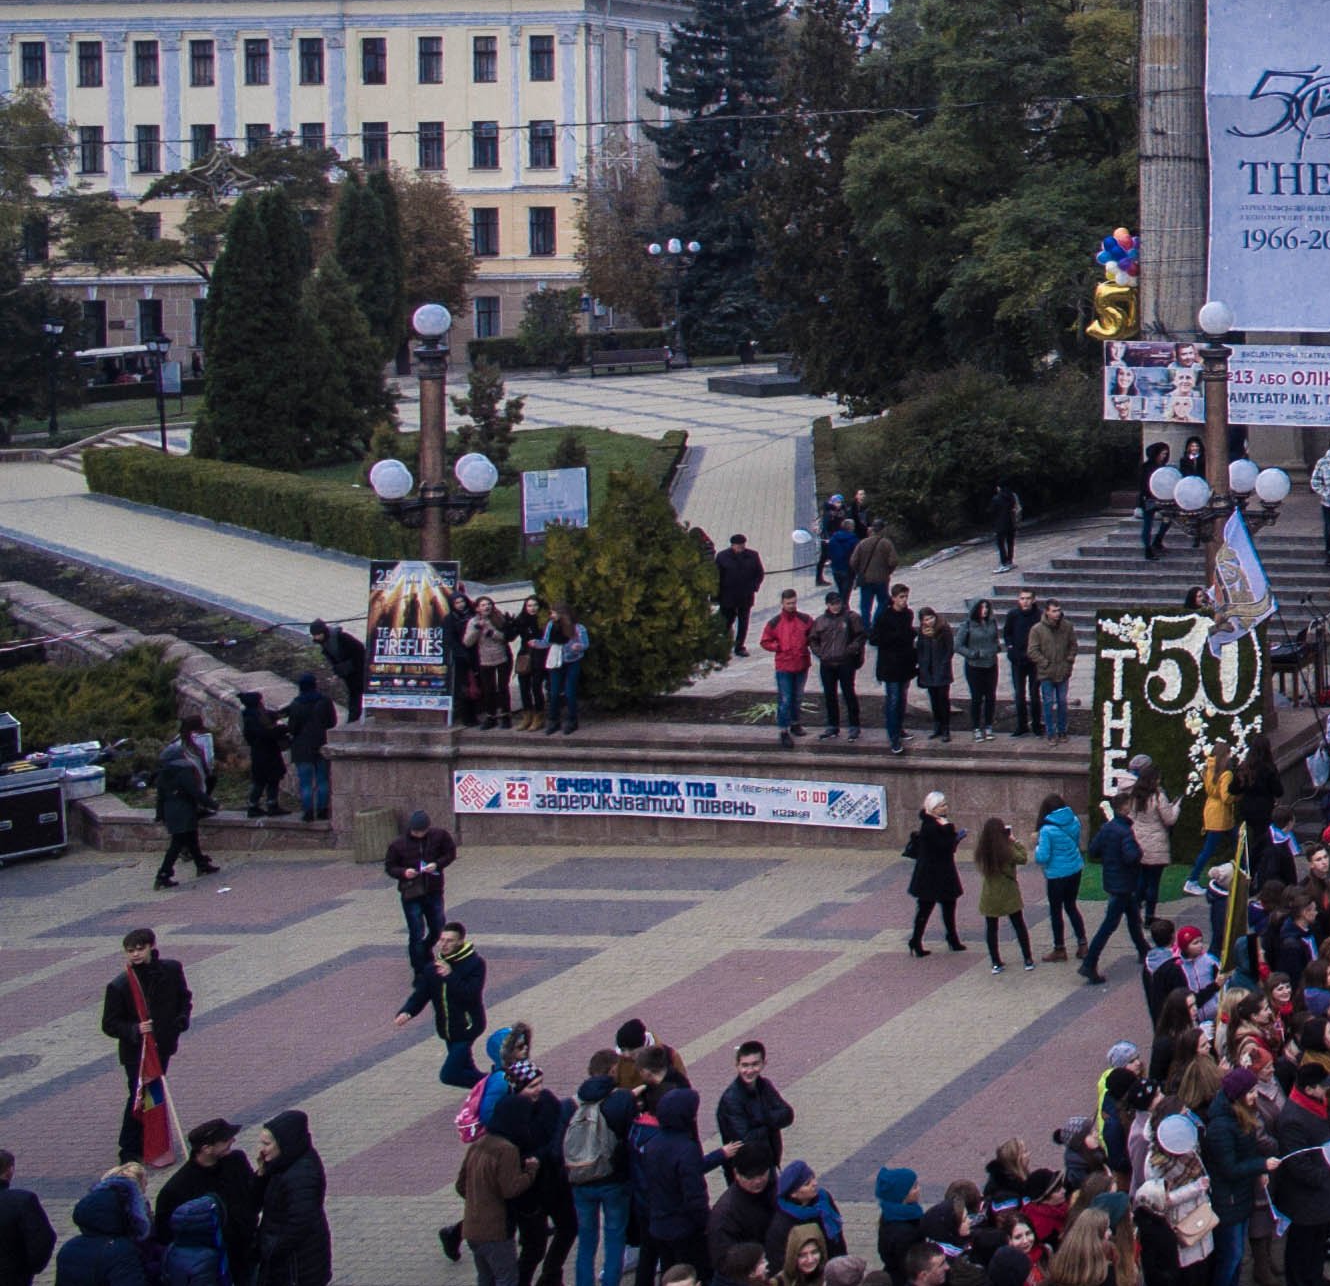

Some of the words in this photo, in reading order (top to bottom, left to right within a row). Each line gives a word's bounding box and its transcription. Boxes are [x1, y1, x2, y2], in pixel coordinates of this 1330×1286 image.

[1260, 374, 1287, 385] АБО
[1228, 392, 1288, 405] АМТЕАТР
[1291, 394, 1310, 405] ІМ.
[1313, 394, 1323, 405] Т.
[376, 627, 408, 639] ТЕАТР
[411, 627, 443, 638] ТІНЕЙ
[376, 639, 443, 656] FIREFLIES
[1144, 613, 1263, 715] 50
[506, 783, 529, 801] 23
